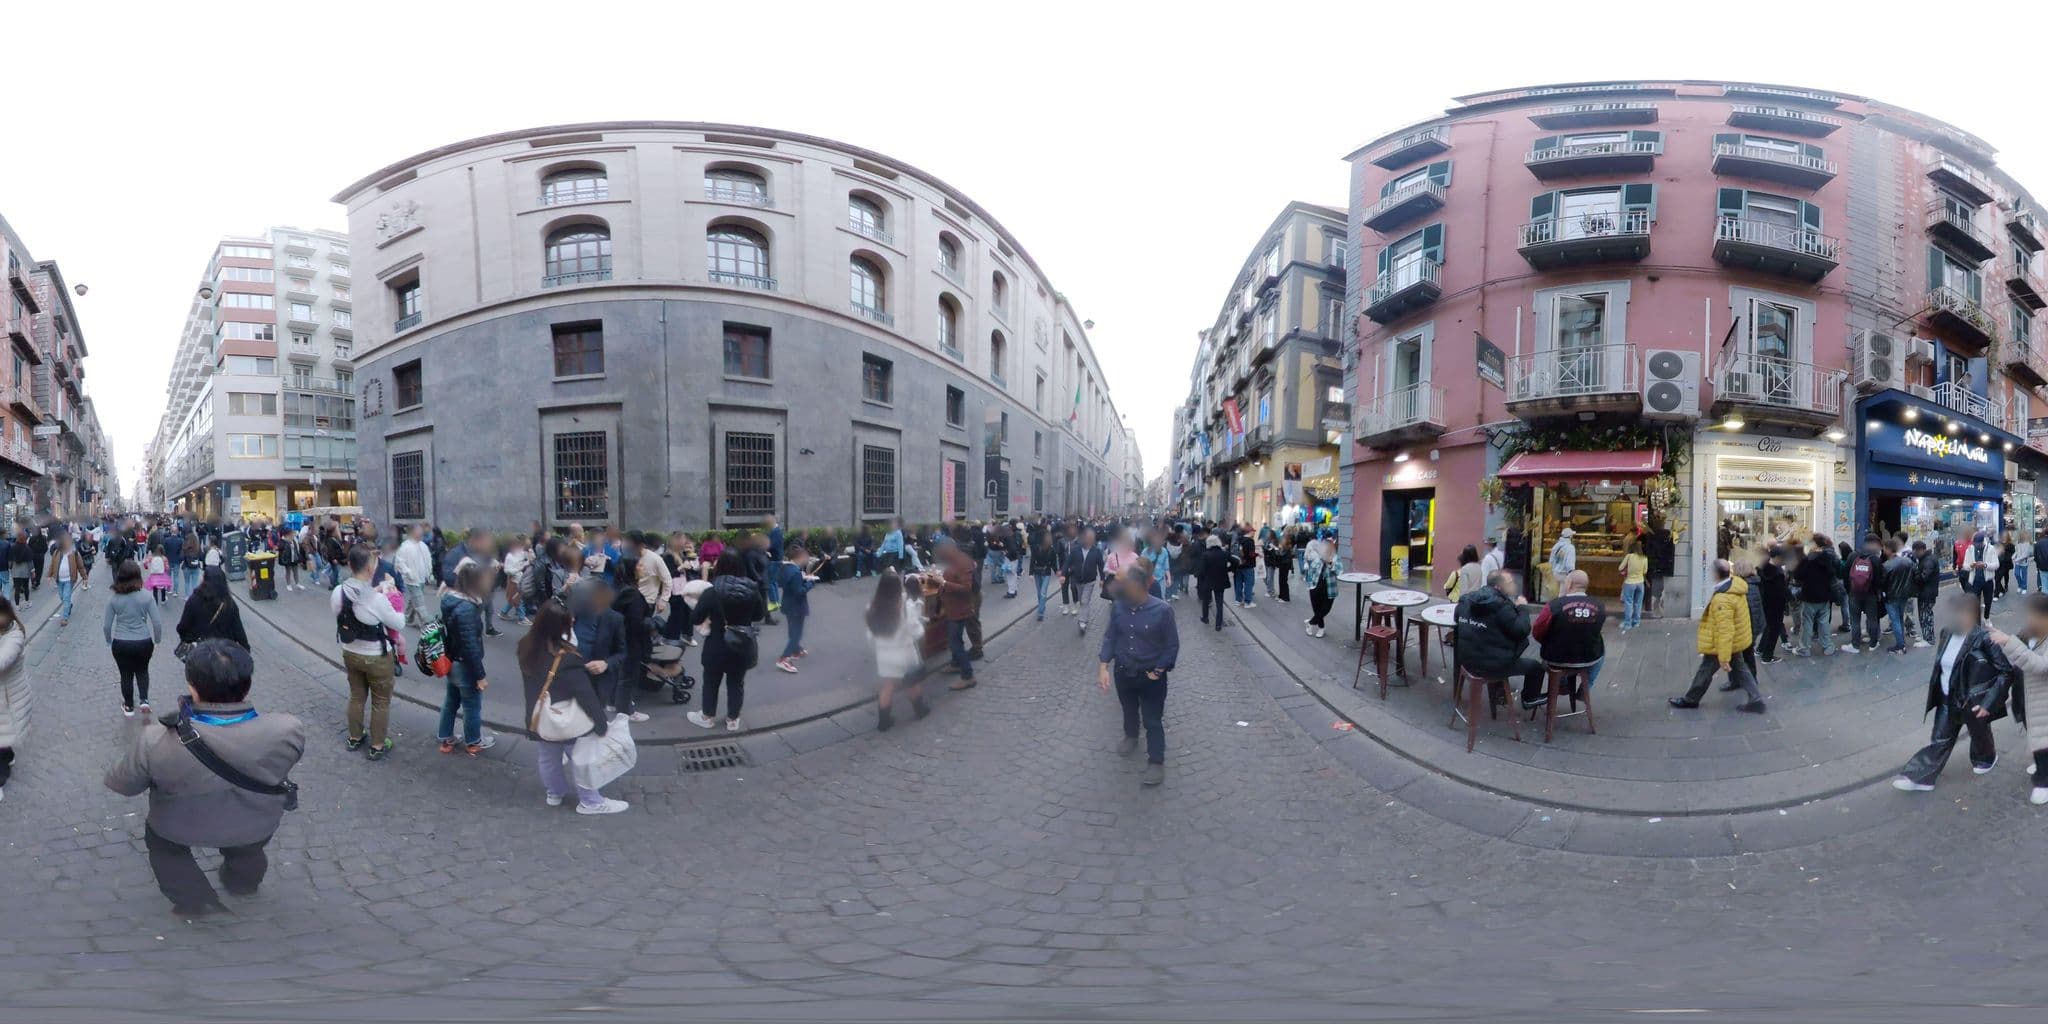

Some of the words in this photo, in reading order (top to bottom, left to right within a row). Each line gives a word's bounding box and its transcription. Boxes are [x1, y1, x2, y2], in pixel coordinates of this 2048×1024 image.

[1923, 475, 1944, 486] People
[1946, 478, 1956, 486] for
[1957, 480, 1975, 489] Naples
